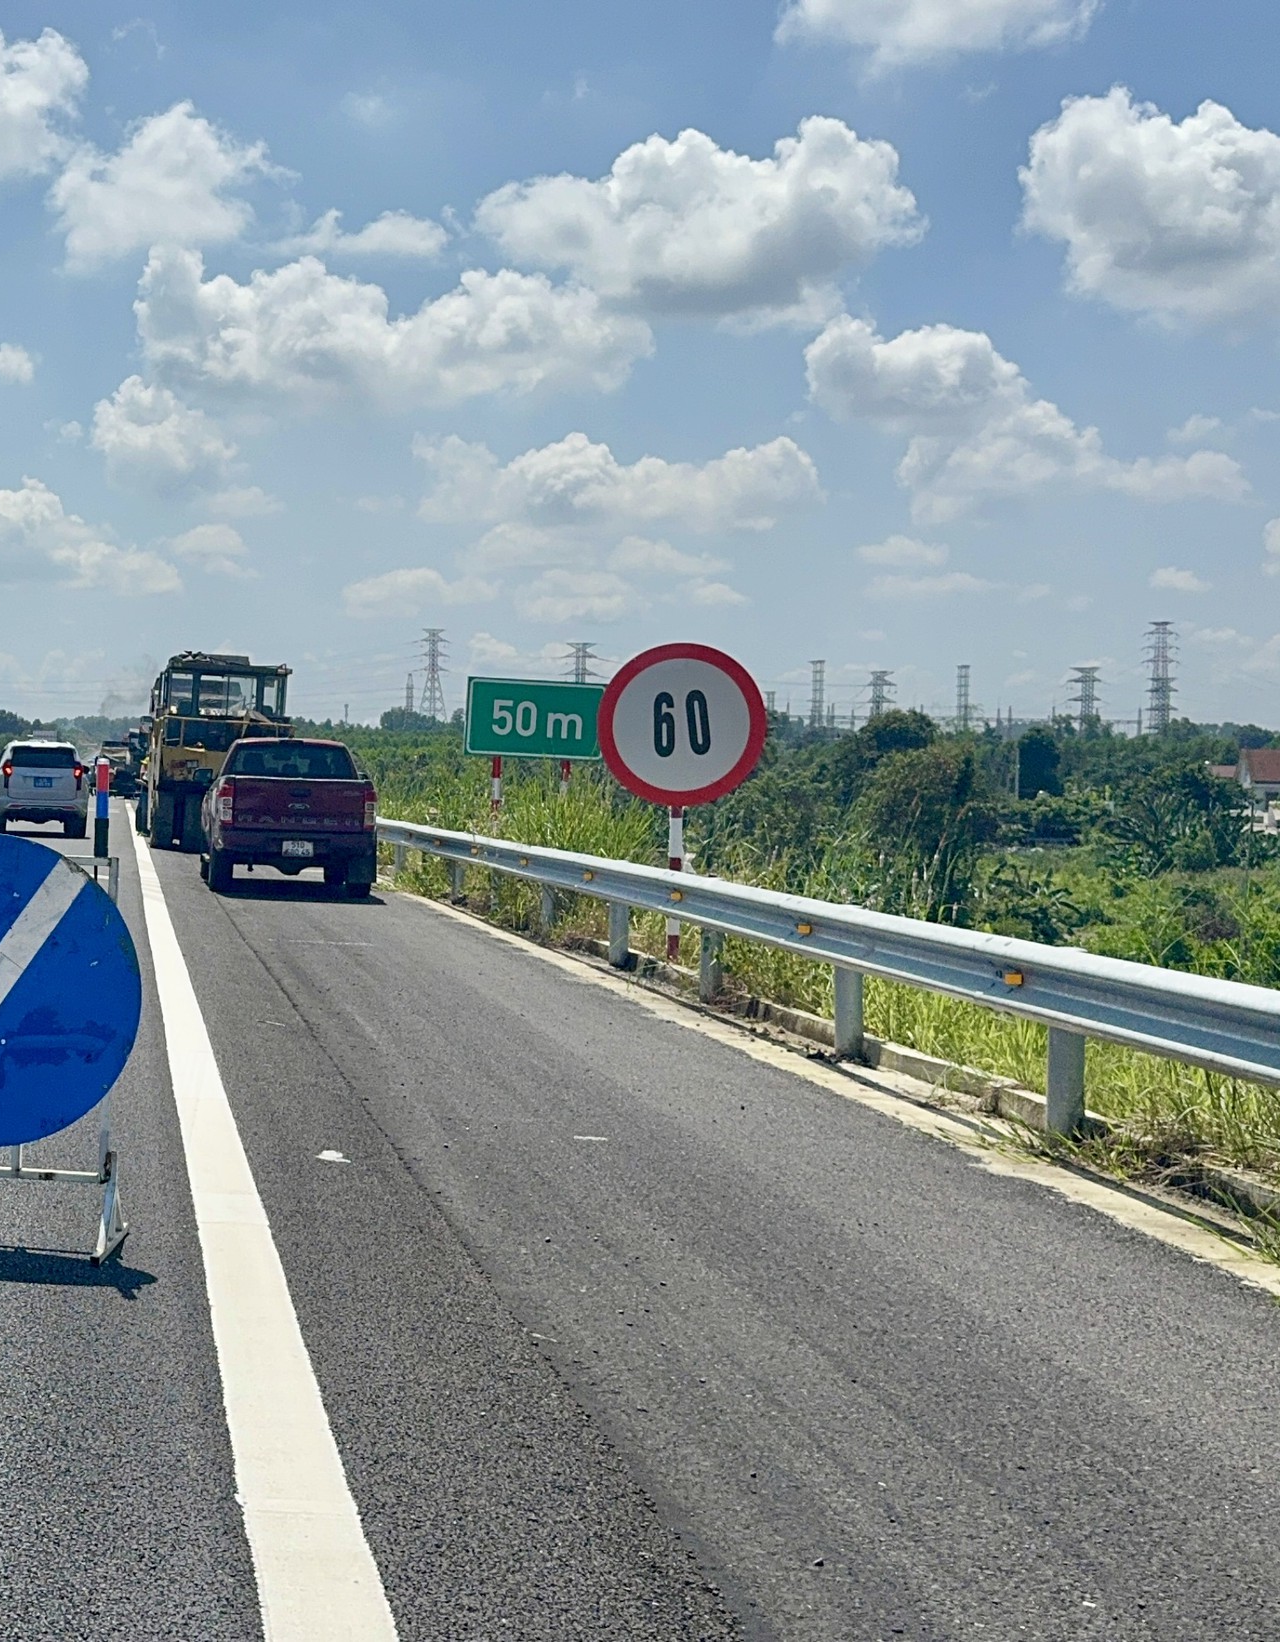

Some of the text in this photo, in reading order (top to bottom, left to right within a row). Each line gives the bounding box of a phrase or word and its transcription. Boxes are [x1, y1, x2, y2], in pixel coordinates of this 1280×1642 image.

[491, 699, 583, 740] 50 m
[653, 689, 711, 758] 60
